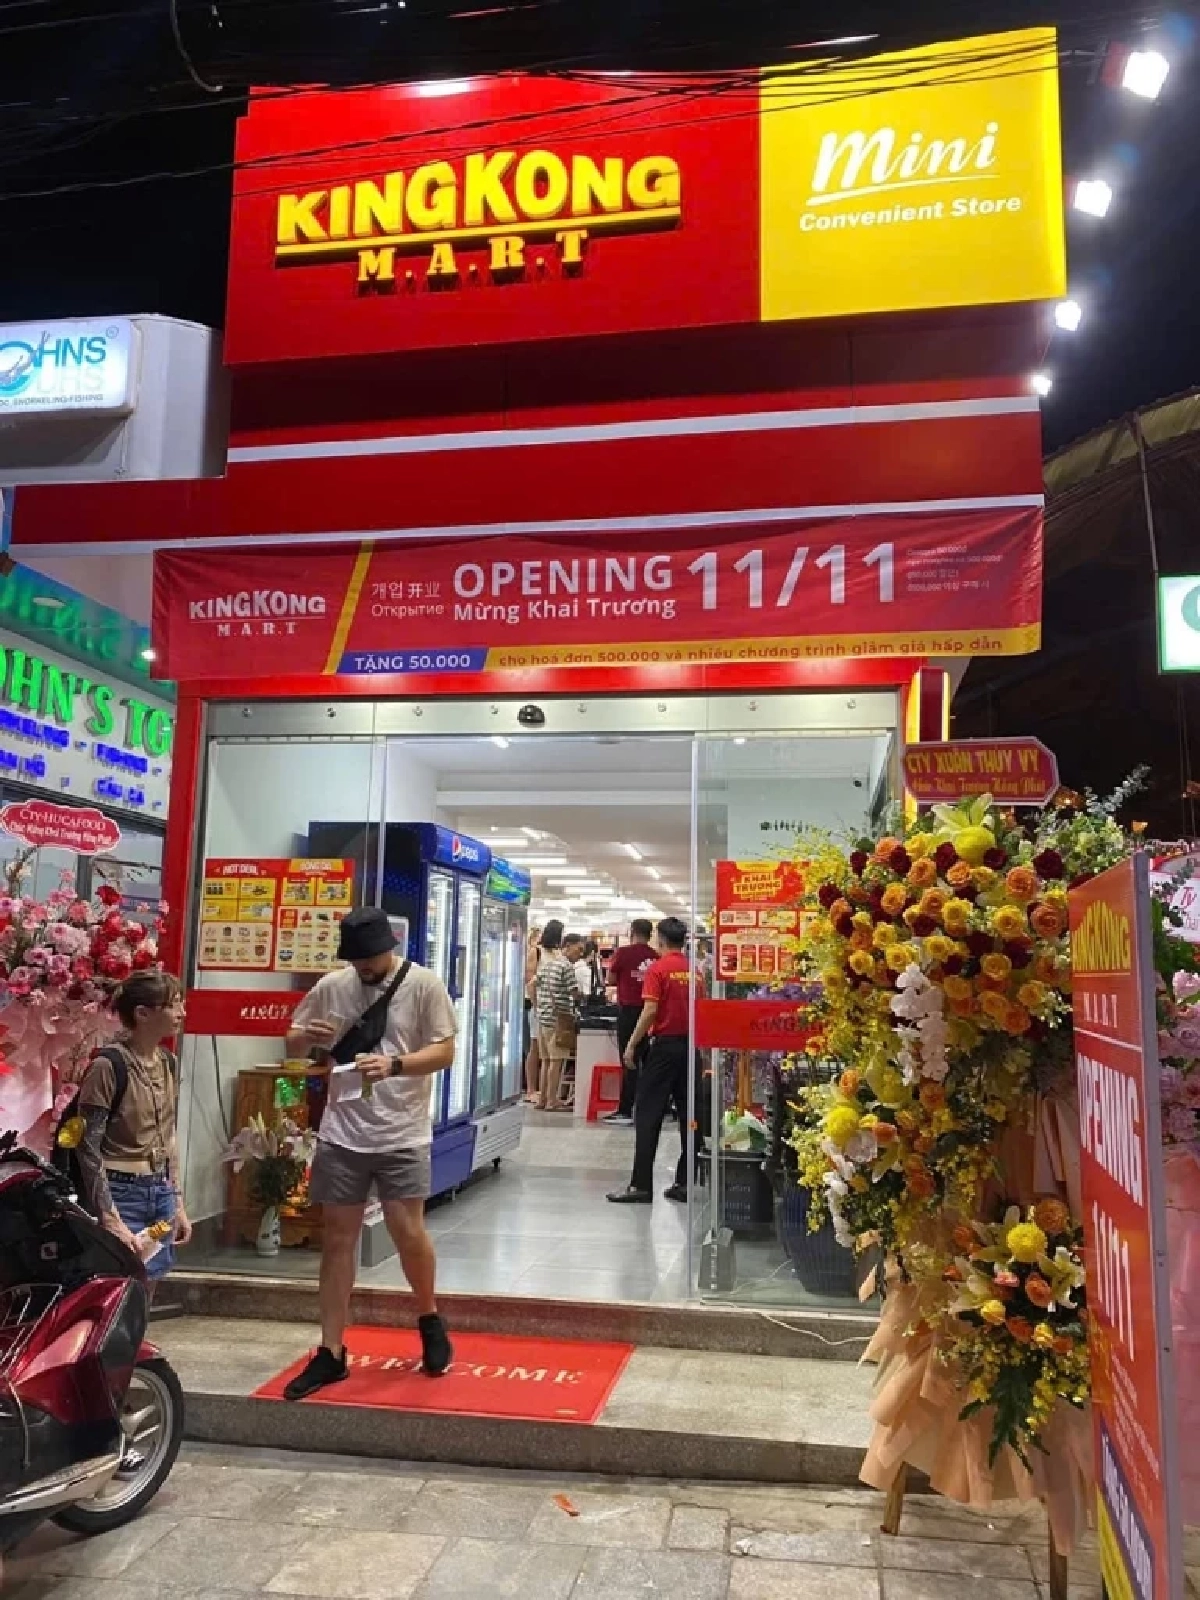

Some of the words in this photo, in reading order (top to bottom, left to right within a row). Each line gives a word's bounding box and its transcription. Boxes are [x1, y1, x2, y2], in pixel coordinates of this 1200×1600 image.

[276, 149, 681, 244] KINGKONG
[799, 201, 945, 232] Convenient
[950, 196, 1021, 217] Store
[358, 230, 588, 282] M.A.R.T
[454, 554, 673, 598] OPENING
[686, 542, 894, 610] 11/11
[189, 588, 326, 620] KINGKONG
[371, 604, 445, 617] Открытие
[454, 602, 520, 625] Mừng
[527, 598, 579, 619] Khai
[586, 597, 677, 620] Trương
[216, 621, 297, 637] M.A.R.T
[355, 653, 404, 675] TẶNG
[409, 654, 472, 670] 50.000
[499, 654, 527, 667] cho
[597, 650, 660, 663] 500.000
[1017, 749, 1039, 773] VY
